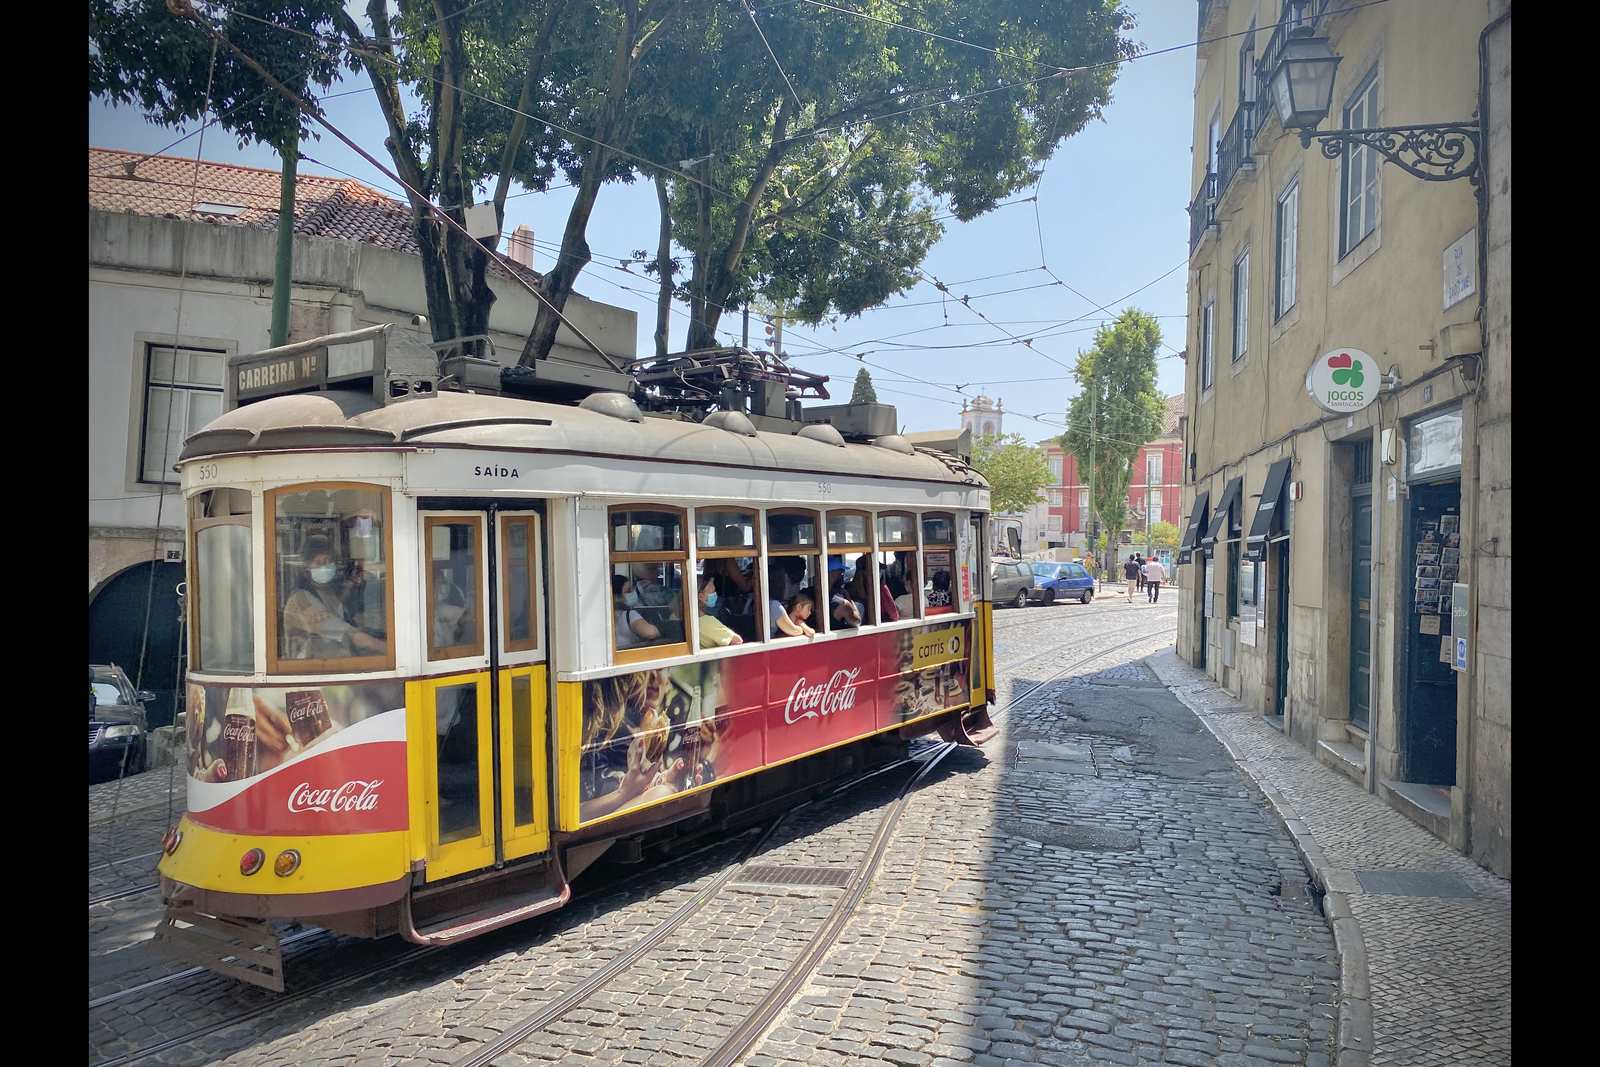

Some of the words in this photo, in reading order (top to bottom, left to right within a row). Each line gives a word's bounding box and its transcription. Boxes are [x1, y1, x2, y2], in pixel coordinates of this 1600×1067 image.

[238, 361, 296, 390] CARREIRA
[302, 356, 317, 377] Nº
[1327, 391, 1364, 403] JOGOS
[199, 464, 218, 480] 550
[474, 464, 519, 478] SAÍDA
[918, 638, 945, 659] carris
[785, 667, 861, 724] Coca-Cola
[288, 780, 384, 813] Coca-Cola
